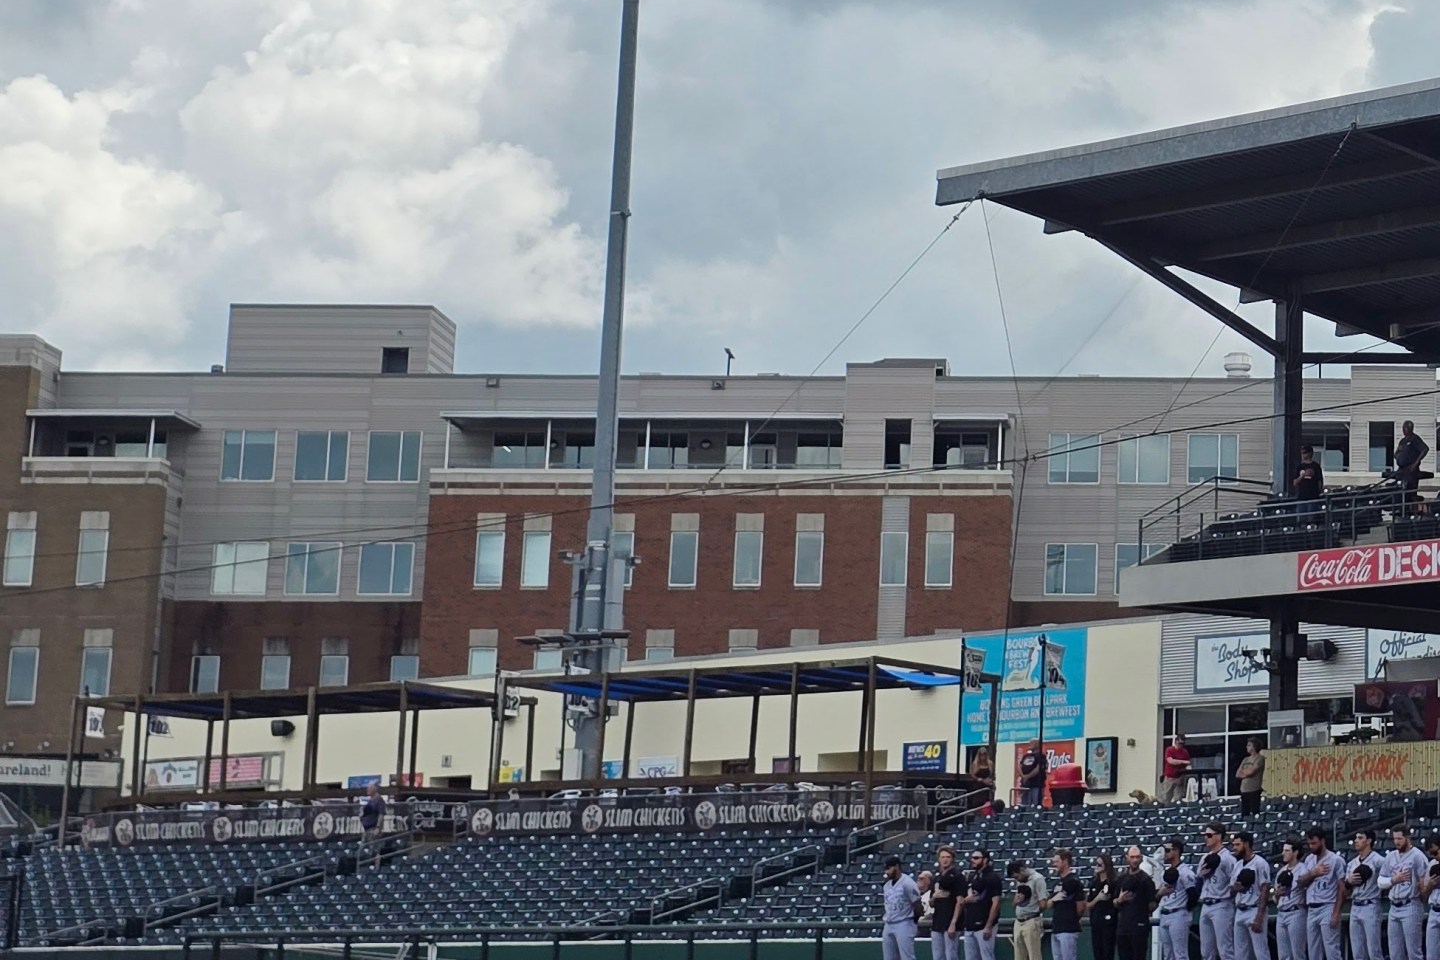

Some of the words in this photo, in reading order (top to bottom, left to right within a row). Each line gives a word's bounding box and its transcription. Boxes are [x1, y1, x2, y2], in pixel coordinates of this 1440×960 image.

[1300, 548, 1376, 588] Coca-Cola
[1008, 658, 1028, 669] FEST
[1224, 660, 1259, 684] Shop
[1011, 696, 1033, 709] GREEN
[966, 711, 987, 723] HOME
[1045, 704, 1081, 718] BREWFEST
[908, 745, 926, 754] NEWS
[924, 744, 941, 758] 40
[1046, 749, 1071, 774] Rods
[1292, 755, 1349, 784] SNACK
[1350, 753, 1411, 782] SHACK
[495, 812, 521, 831] SLIM
[522, 810, 572, 829] CHICKENS
[604, 808, 632, 827] SLIM
[634, 807, 686, 826] CHICKENS
[718, 804, 747, 824] SLIM
[748, 803, 802, 823] CHICKENS
